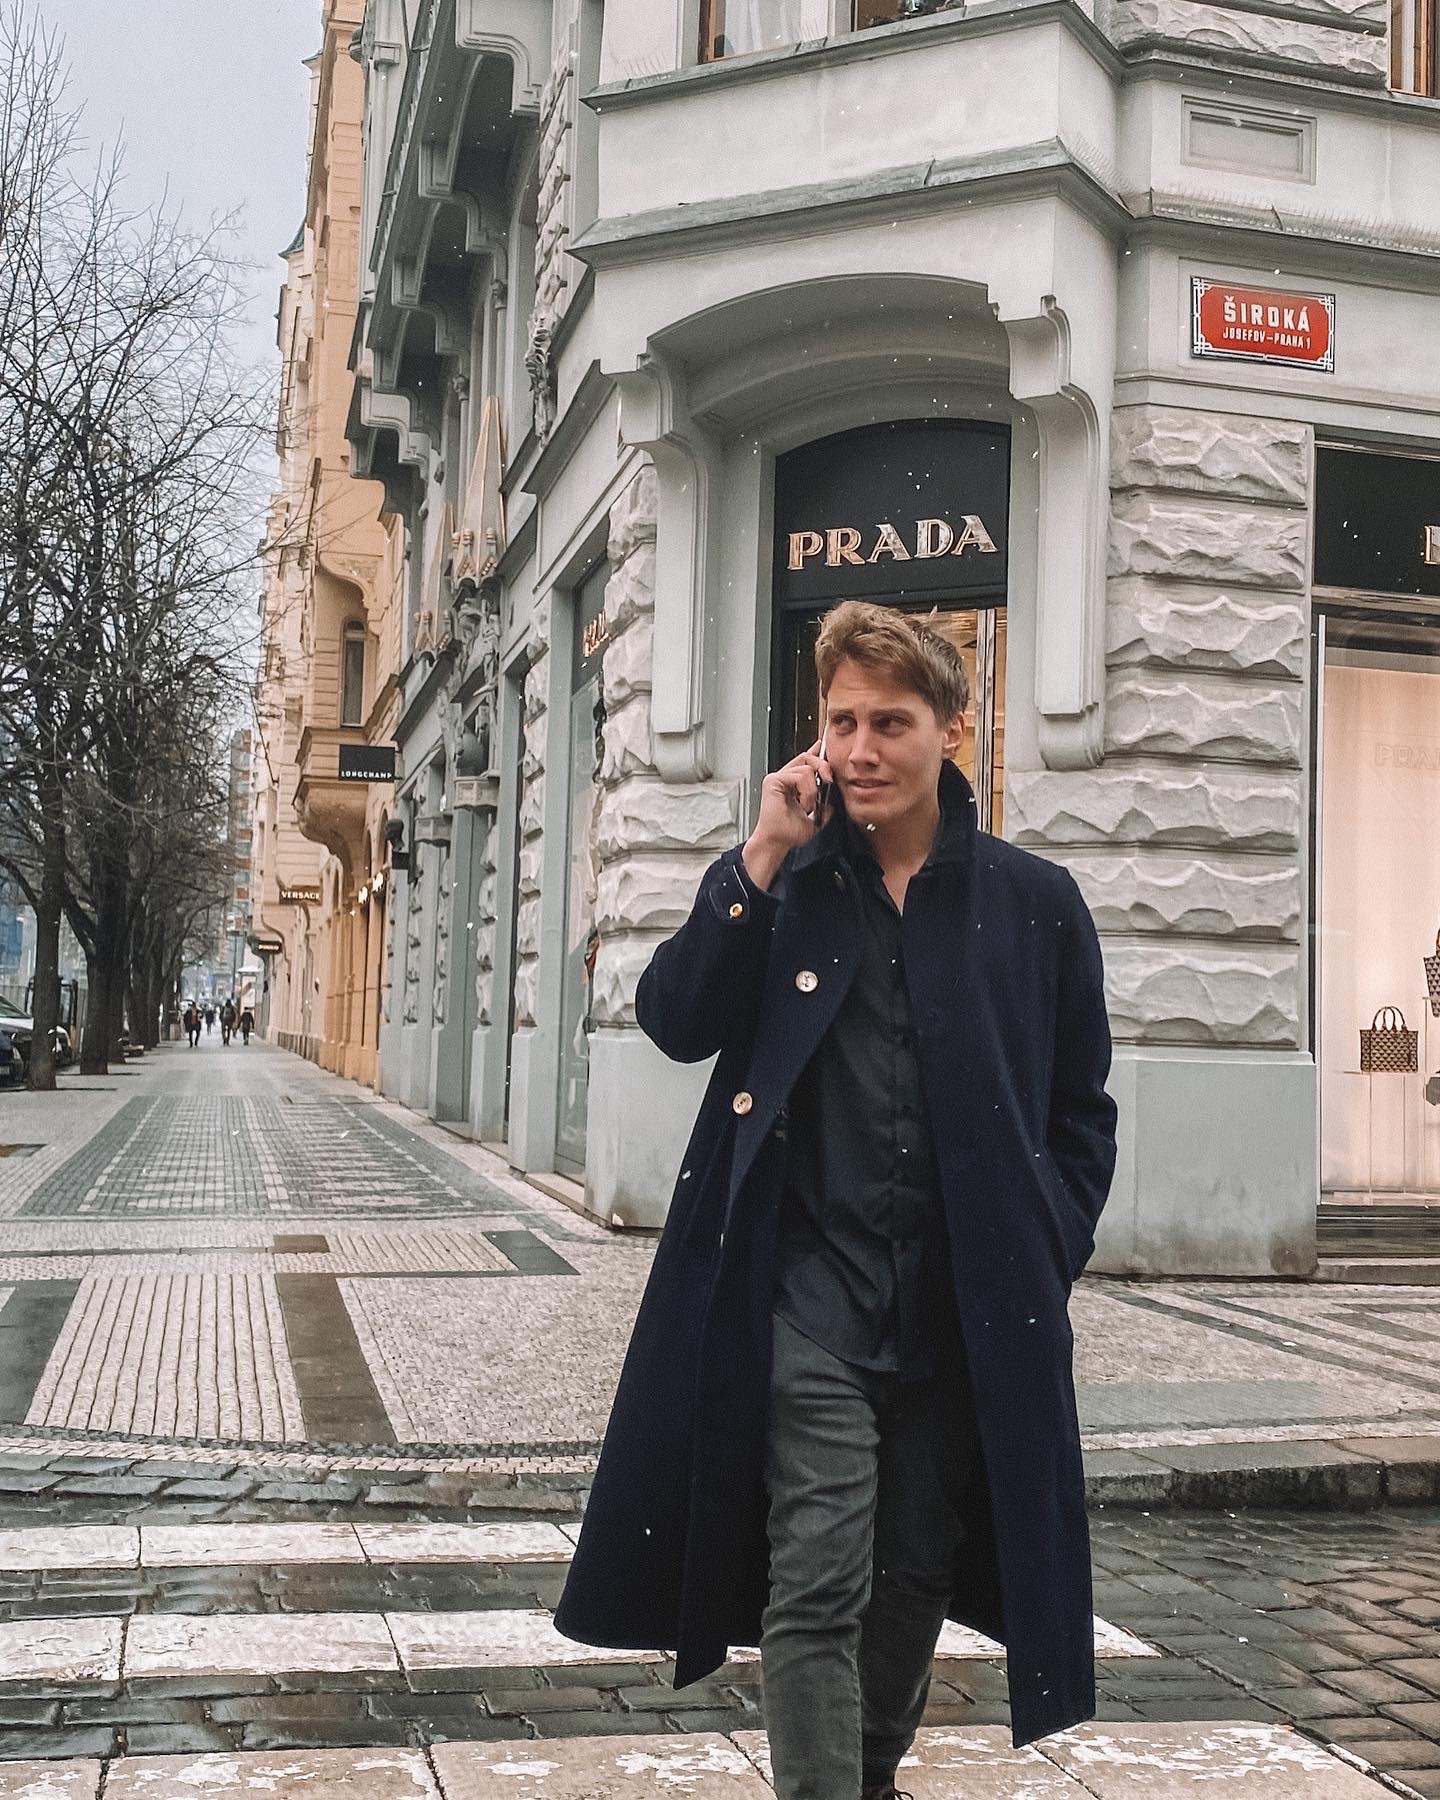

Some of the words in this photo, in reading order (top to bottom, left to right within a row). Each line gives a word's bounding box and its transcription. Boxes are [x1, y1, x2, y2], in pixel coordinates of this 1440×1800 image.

[1223, 295, 1311, 333] ŠIROKÁ
[1306, 336, 1312, 350] 1
[787, 514, 999, 571] PRADA
[341, 770, 393, 779] LONGCHAMP
